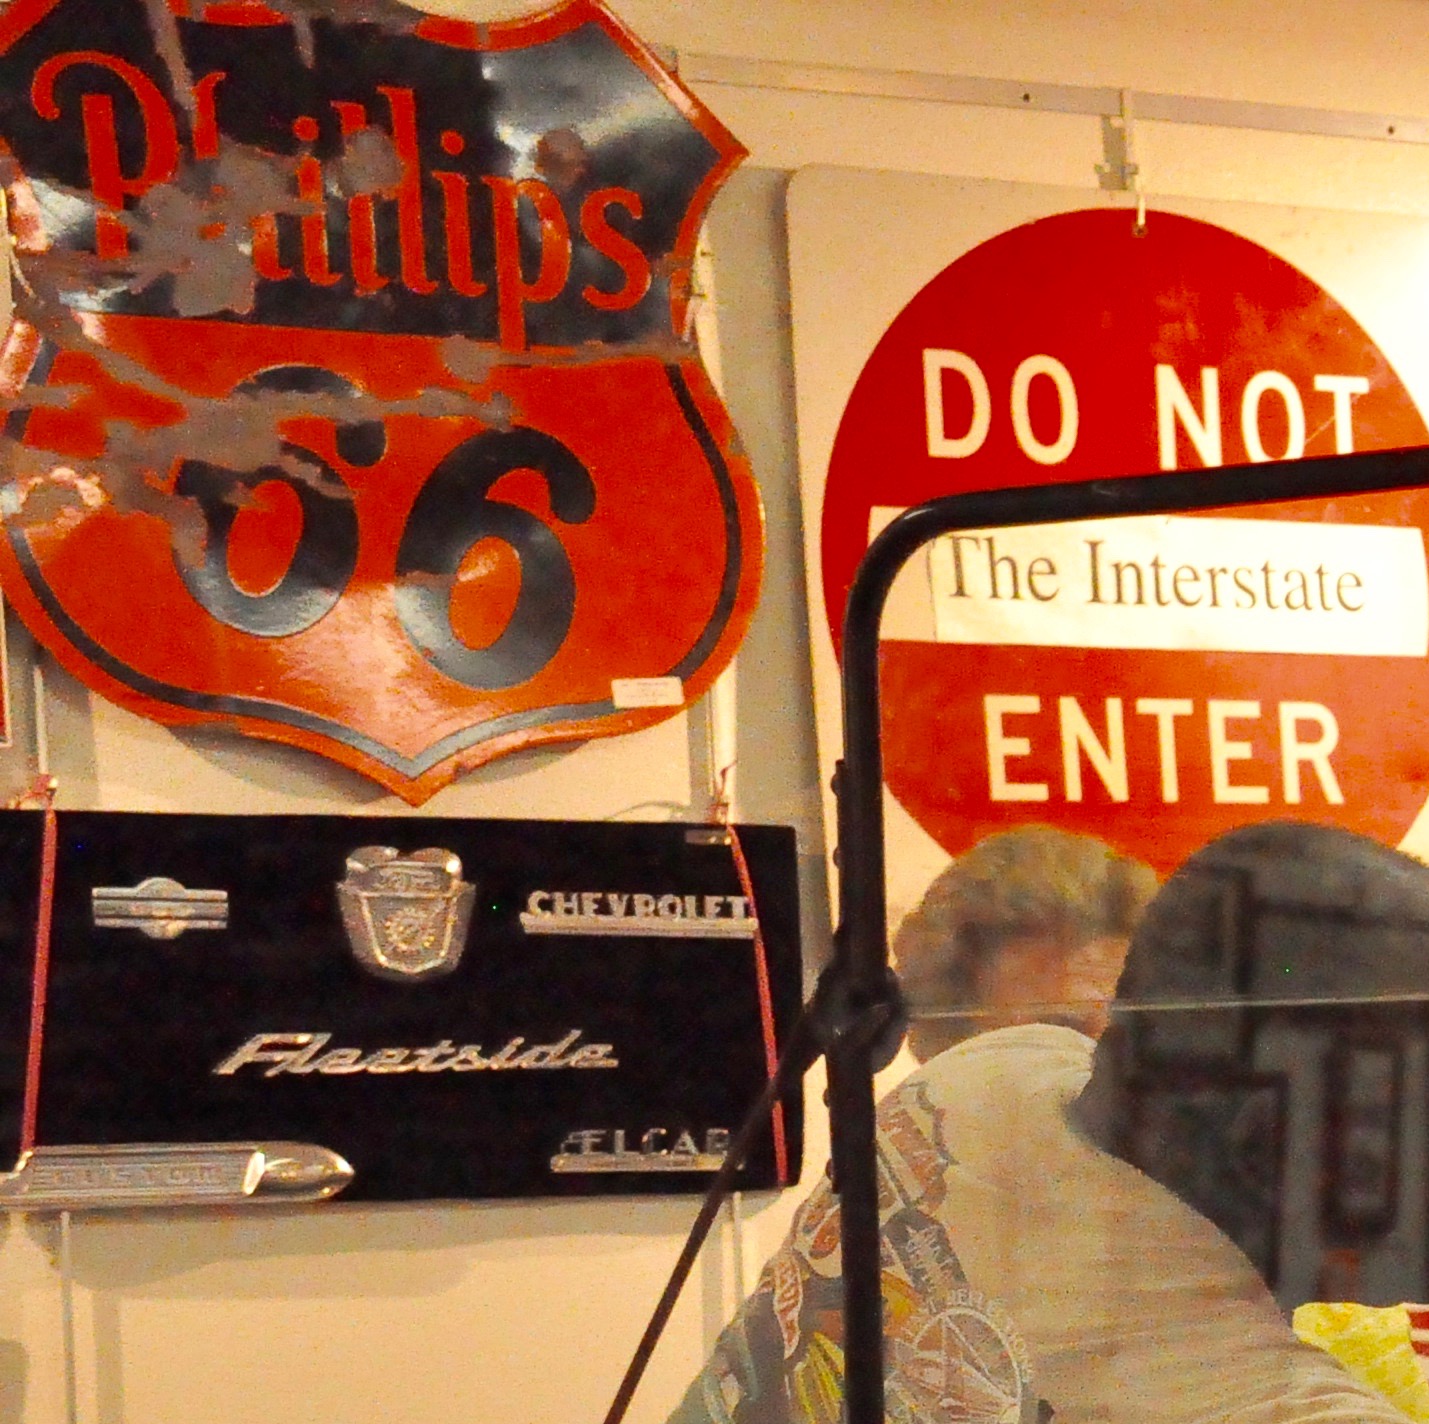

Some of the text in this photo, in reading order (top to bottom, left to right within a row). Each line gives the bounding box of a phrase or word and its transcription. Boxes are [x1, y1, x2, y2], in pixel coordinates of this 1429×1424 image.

[922, 348, 1371, 471] DO NOT
[945, 535, 1366, 614] The Interstate
[983, 694, 1346, 806] ENTER
[528, 889, 751, 920] CHEVROLET
[212, 1028, 620, 1078] Fleetside
